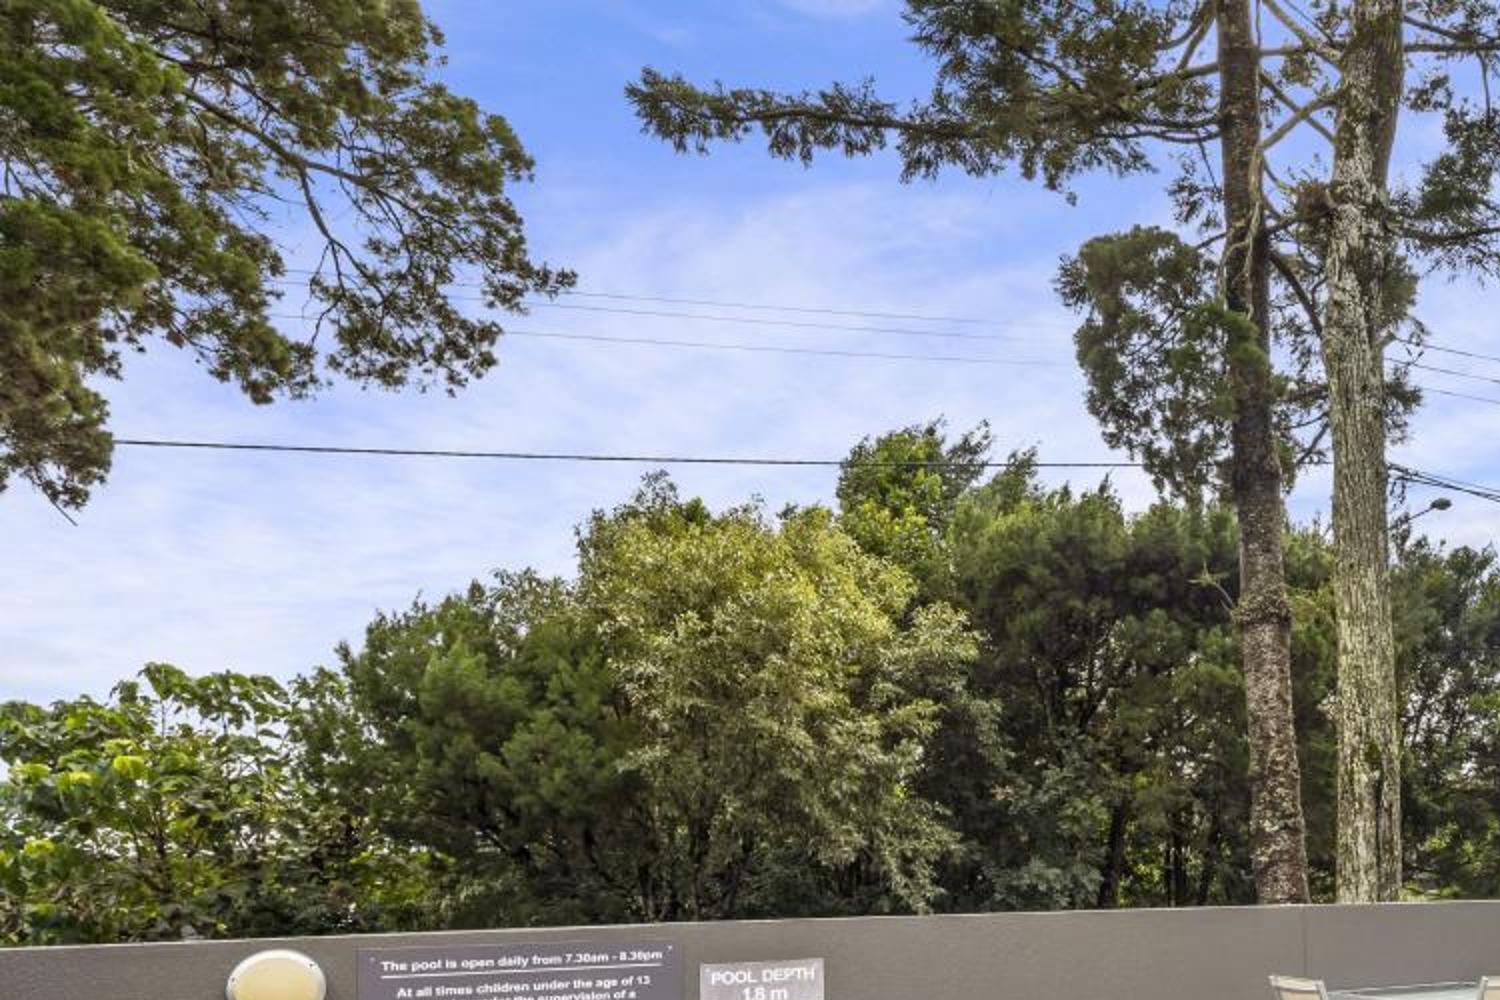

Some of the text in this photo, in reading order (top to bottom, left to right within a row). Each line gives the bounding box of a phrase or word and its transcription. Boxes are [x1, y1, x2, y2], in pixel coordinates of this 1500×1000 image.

[381, 961, 408, 971] The
[411, 960, 441, 972] pool
[445, 960, 457, 968] is
[461, 959, 494, 969] open
[497, 956, 529, 968] daily
[532, 954, 562, 965] from
[565, 953, 609, 962] 7.30am
[711, 967, 815, 985] POOL DEPTH
[397, 975, 651, 998] At all times children under the age of 13
[613, 990, 626, 1000] of
[628, 991, 636, 999] a
[770, 989, 788, 1000] m
